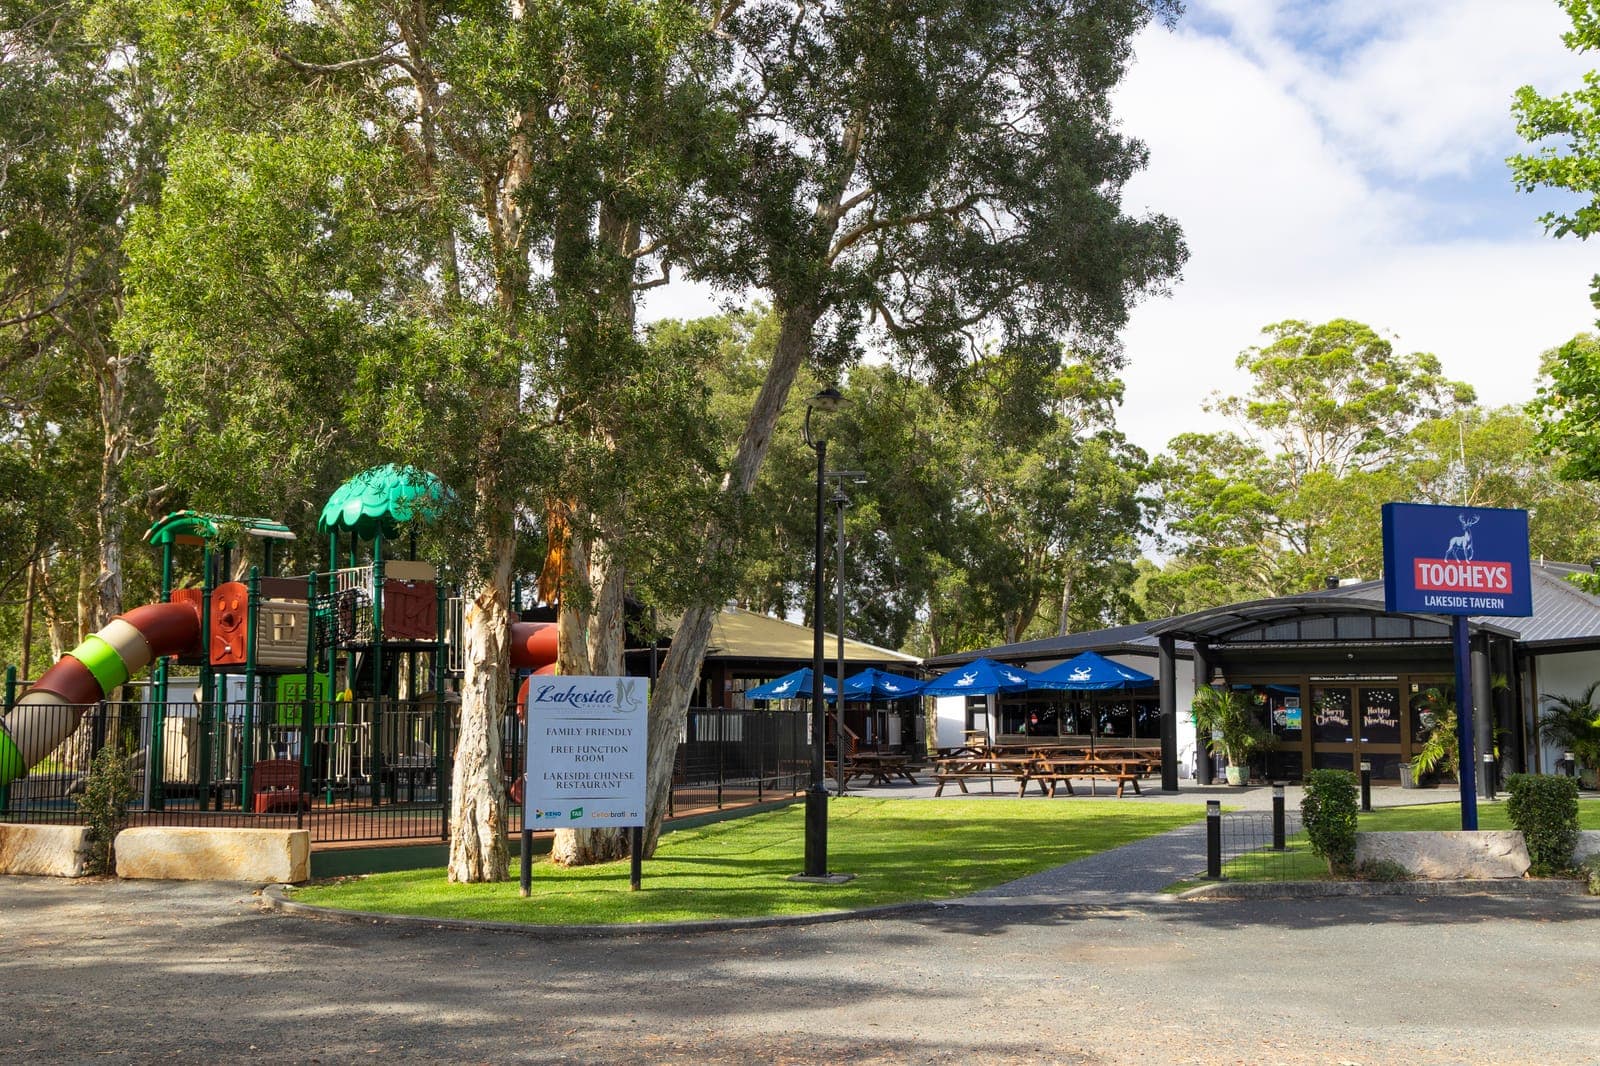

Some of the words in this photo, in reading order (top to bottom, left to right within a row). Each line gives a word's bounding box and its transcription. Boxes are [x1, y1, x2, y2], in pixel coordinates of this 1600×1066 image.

[1418, 563, 1508, 589] TOOHEYS
[1424, 595, 1468, 608] LAKESIDE
[1469, 597, 1504, 609] TAVERN
[535, 685, 615, 708] Lakeside
[1321, 707, 1345, 717] Merry
[546, 727, 583, 737] FAMILY
[585, 727, 633, 737] FRIENDLY
[550, 745, 574, 754] FREE
[577, 745, 629, 754] FUNCTION
[575, 754, 605, 762] ROOM
[543, 771, 591, 780] LAKESIDE
[594, 771, 635, 780] CHINESE
[556, 780, 622, 789] RESTAURANT
